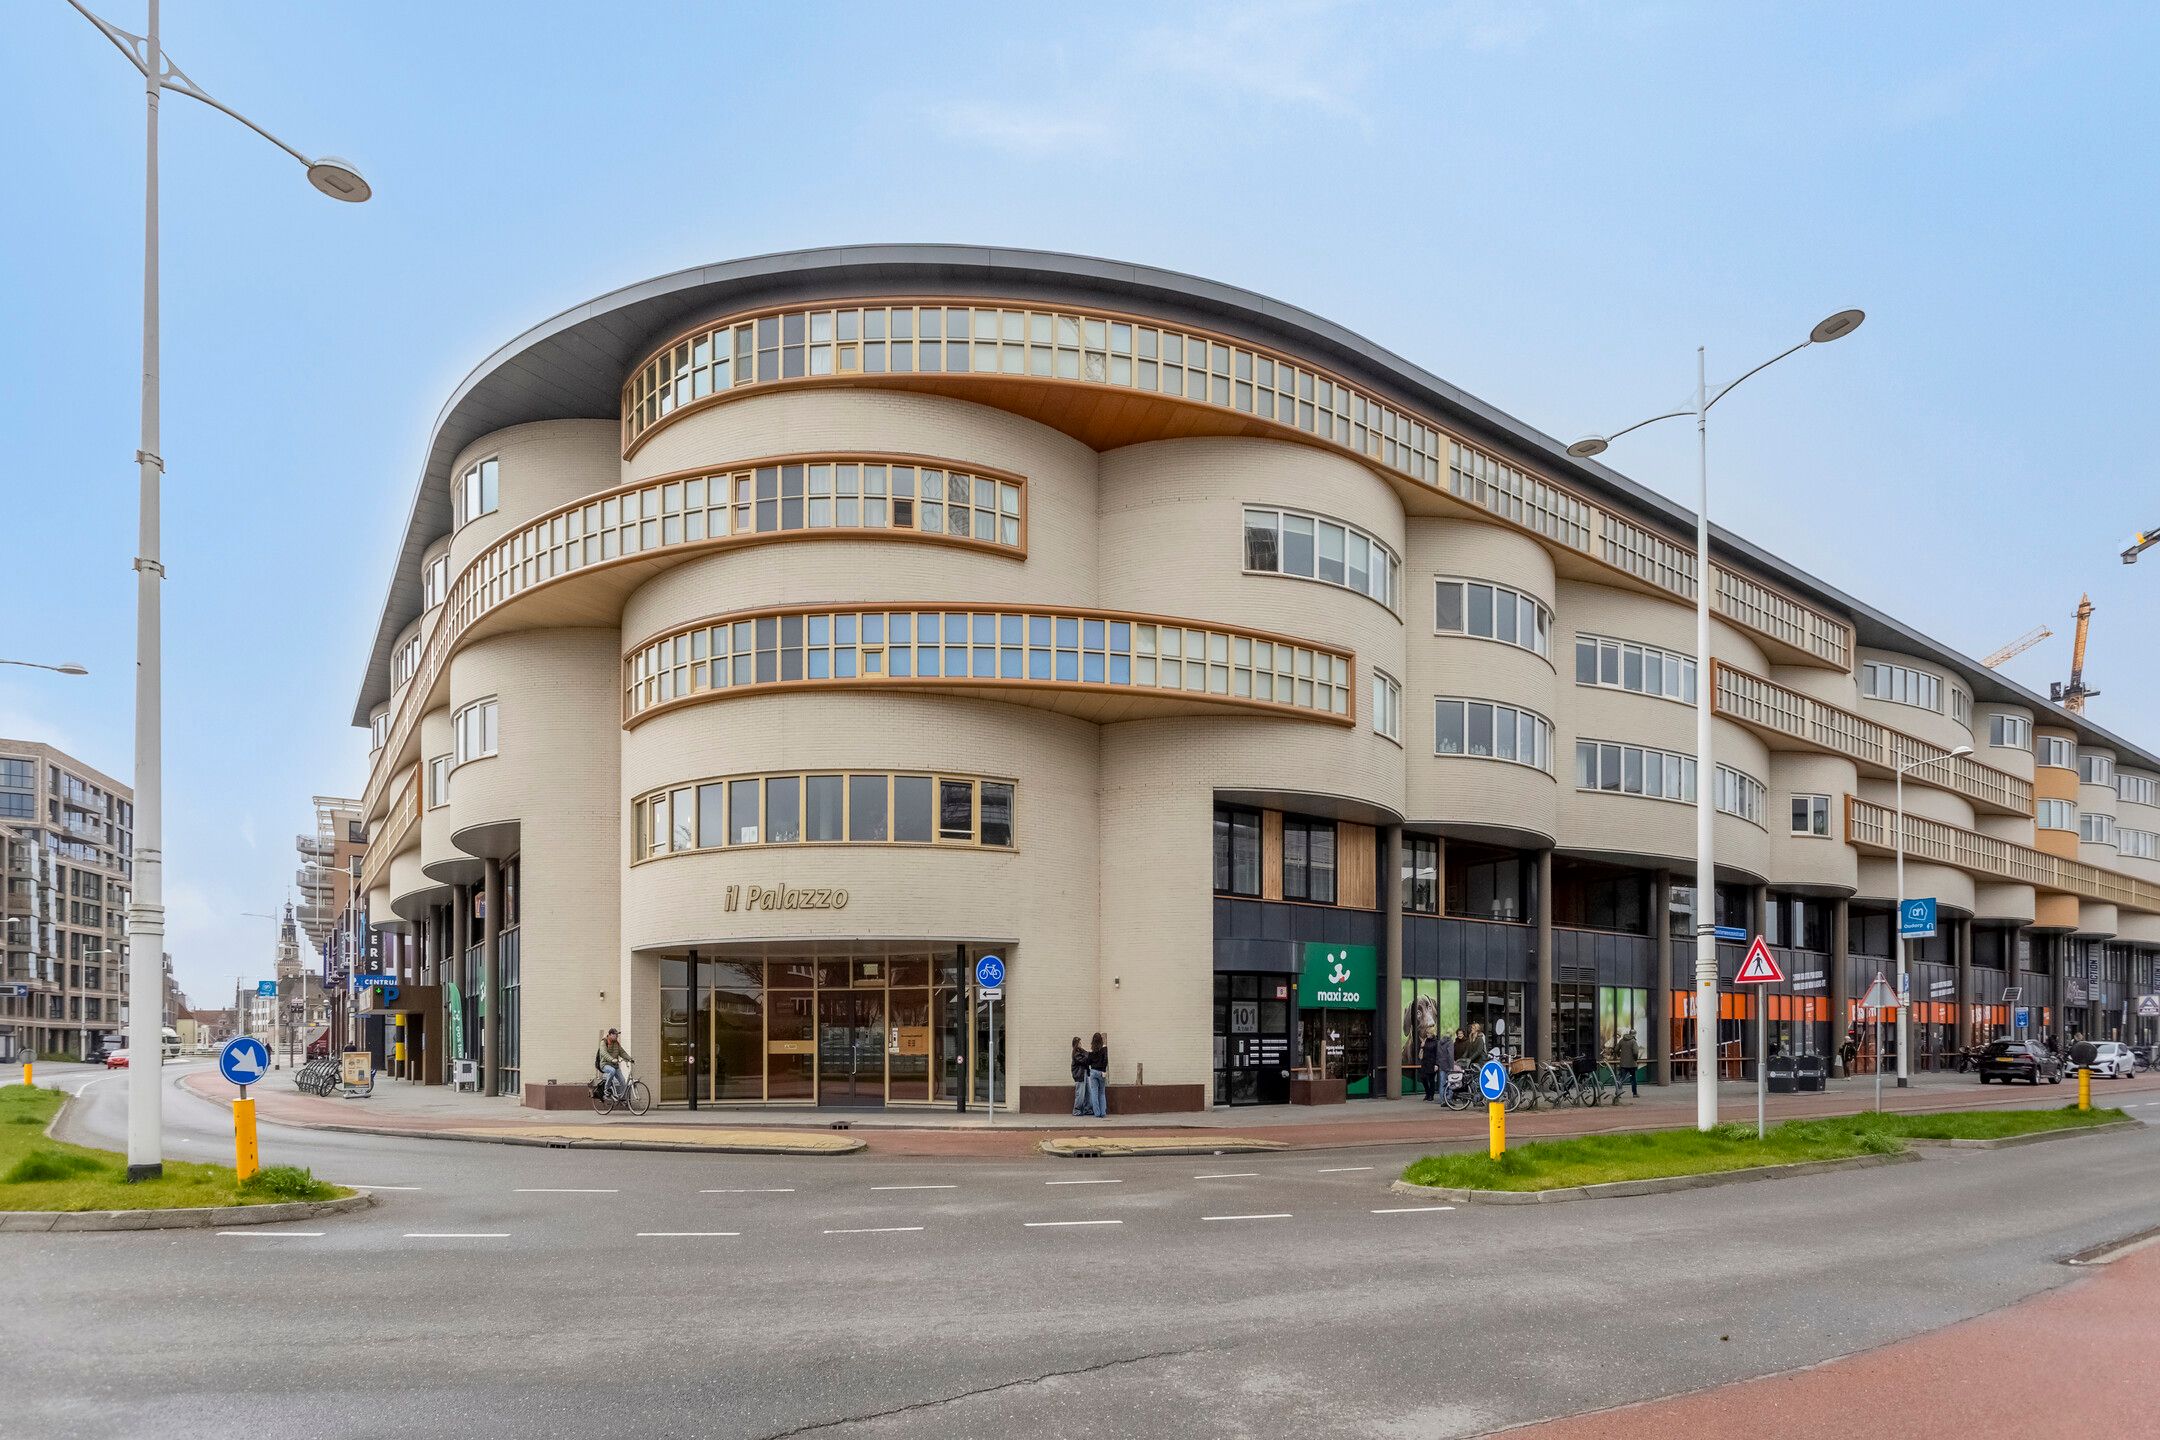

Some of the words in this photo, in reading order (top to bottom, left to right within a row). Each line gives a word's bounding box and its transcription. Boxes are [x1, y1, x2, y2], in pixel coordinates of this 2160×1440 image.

[724, 885, 739, 912] il
[745, 883, 849, 911] Palazzo
[2090, 960, 2098, 985] ACTION
[384, 987, 399, 1007] P
[1317, 987, 1341, 1001] maxi
[1342, 992, 1360, 1002] zoo
[1233, 1008, 1255, 1025] 101
